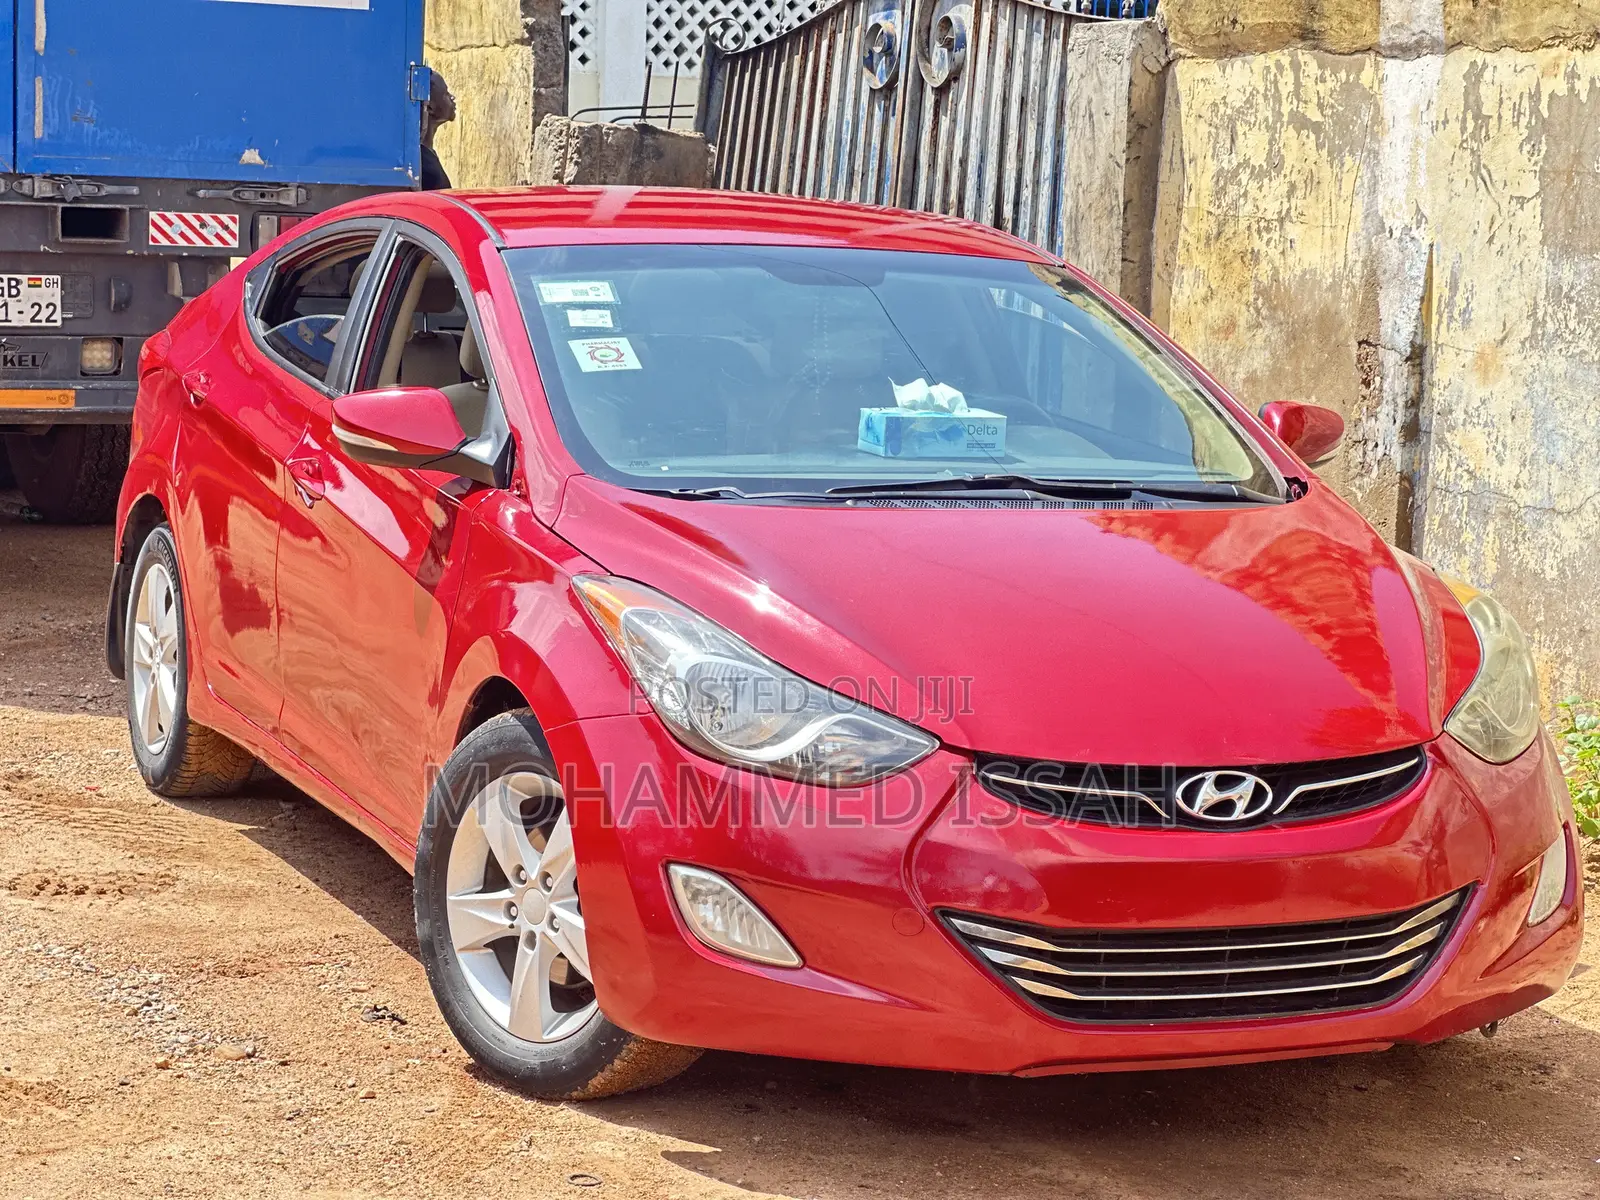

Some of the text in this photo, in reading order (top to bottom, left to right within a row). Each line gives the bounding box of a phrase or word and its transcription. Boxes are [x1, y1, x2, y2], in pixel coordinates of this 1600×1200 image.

[44, 277, 59, 288] GH
[30, 302, 58, 323] 22
[967, 424, 998, 435] Delta
